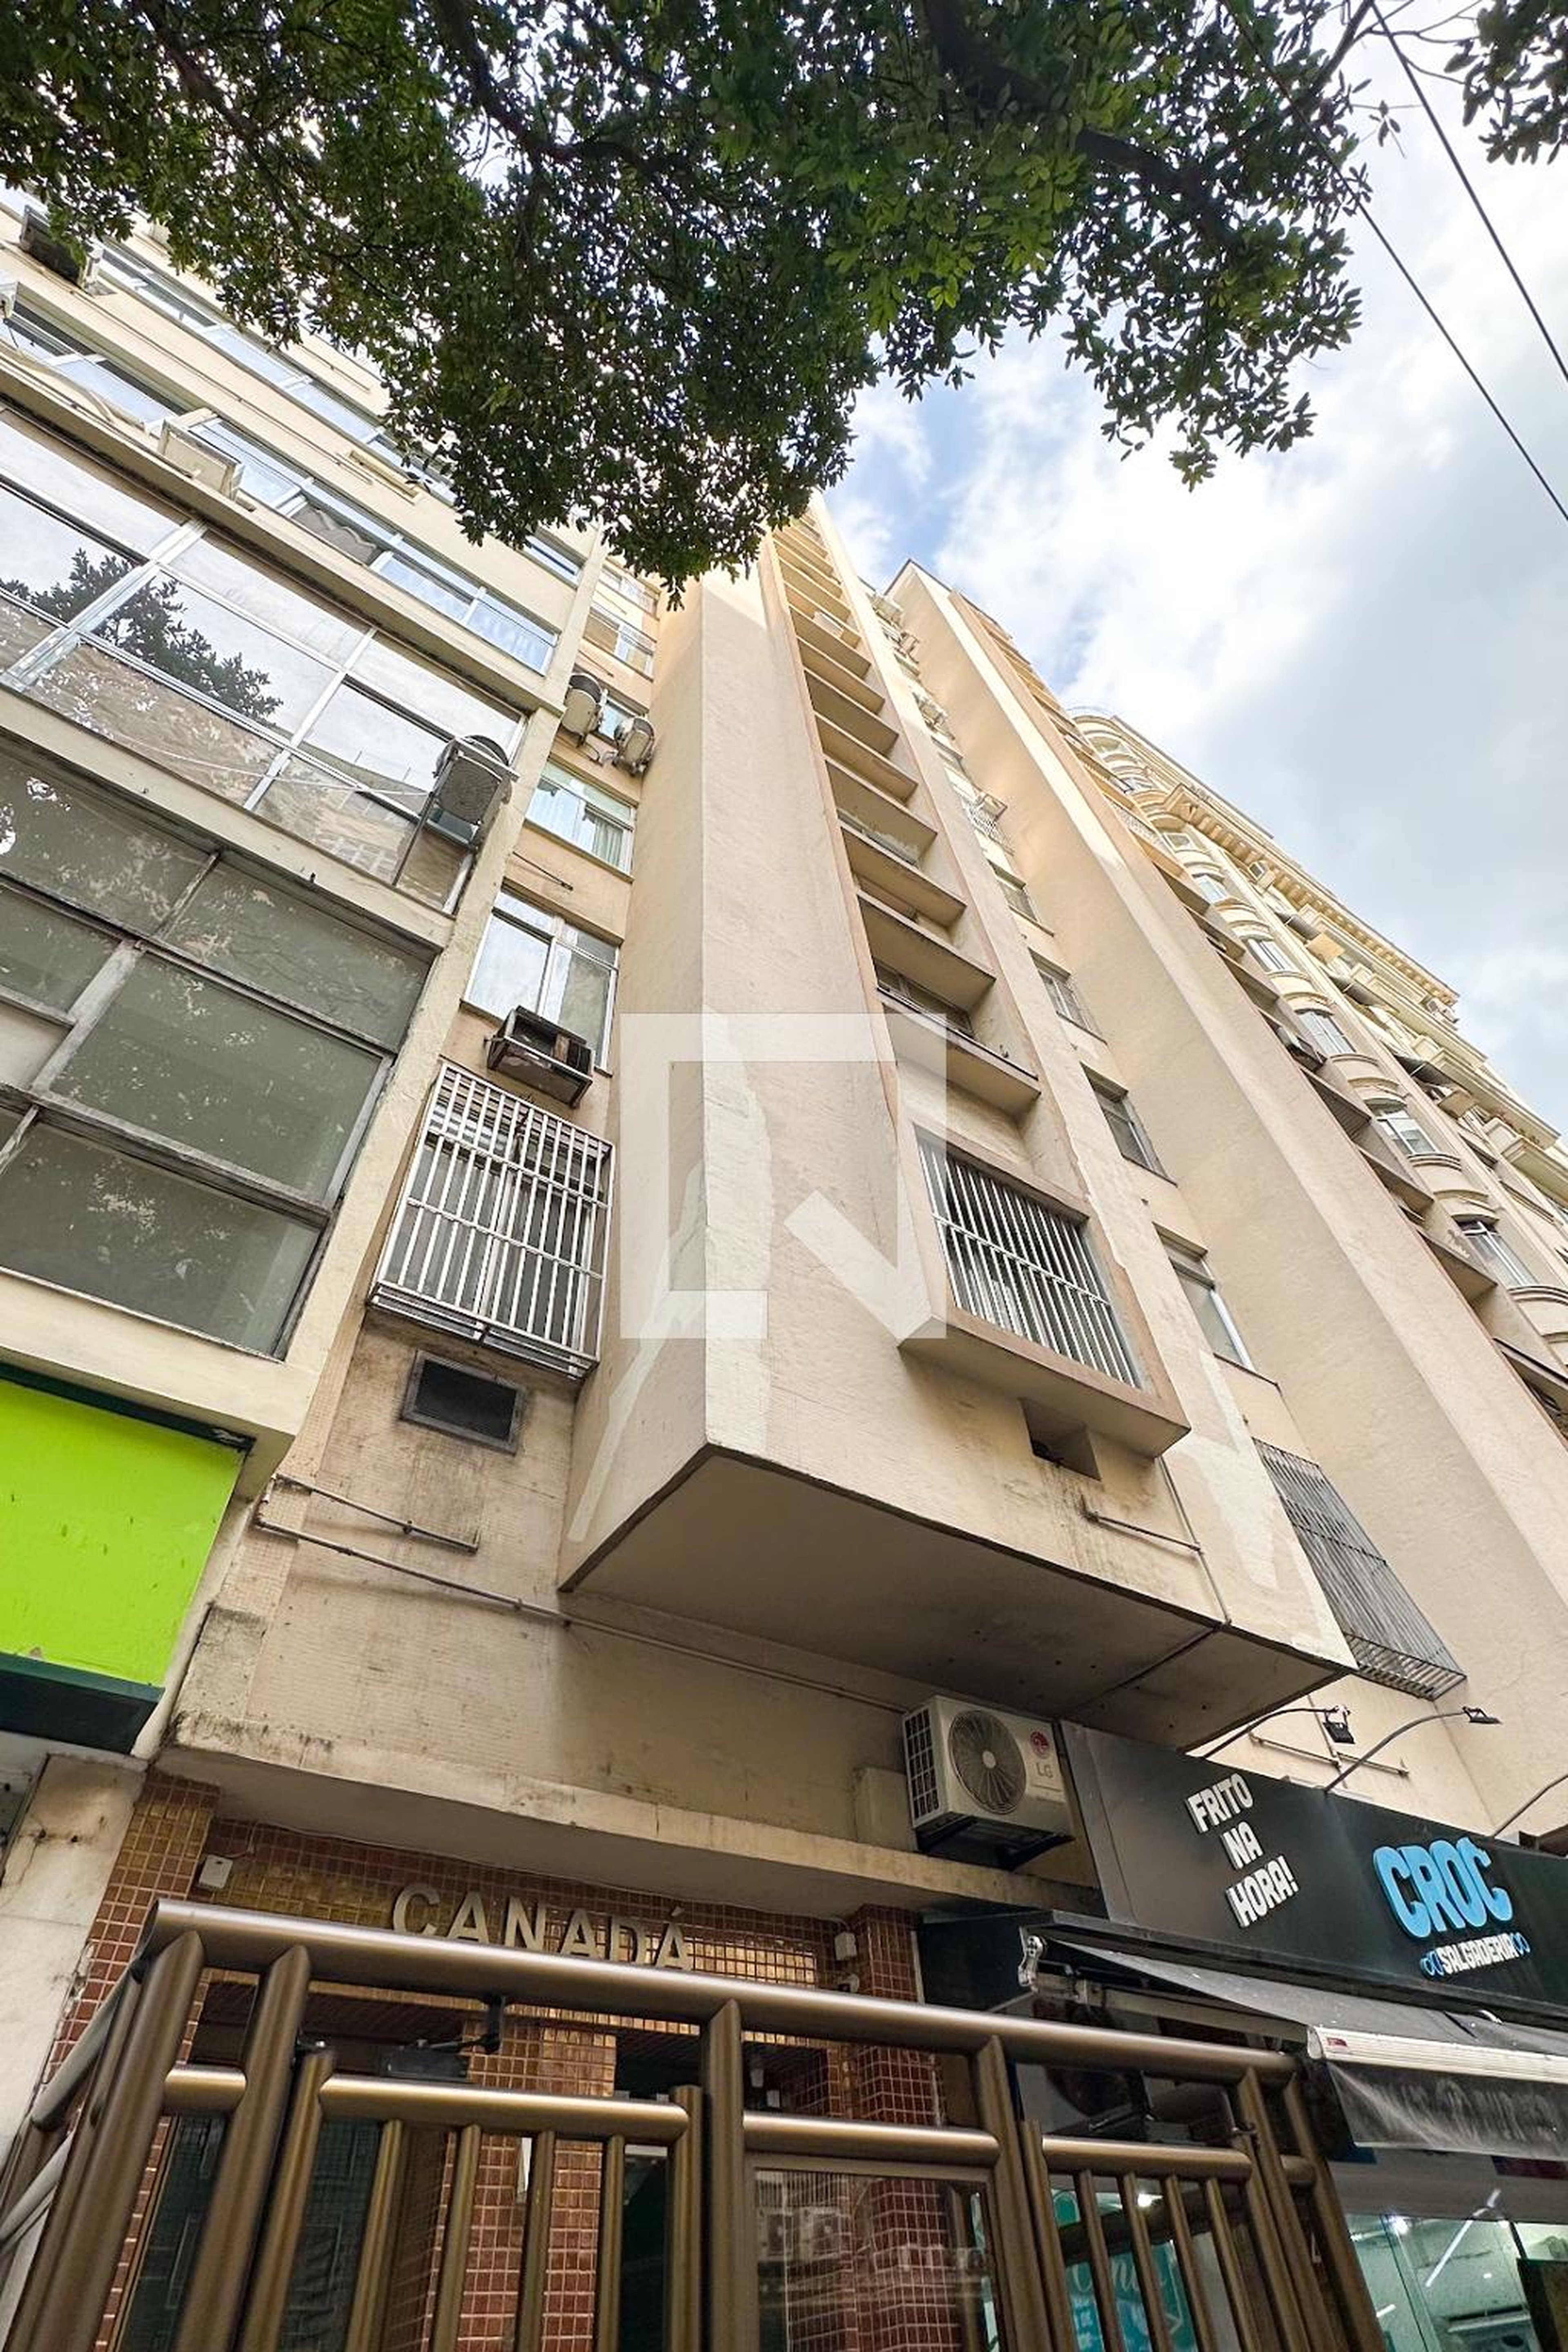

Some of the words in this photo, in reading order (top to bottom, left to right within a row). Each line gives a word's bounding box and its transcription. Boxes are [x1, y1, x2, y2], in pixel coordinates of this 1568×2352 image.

[1036, 1762, 1054, 1778] LG
[1186, 1773, 1254, 1833] FRITO
[1221, 1821, 1264, 1870] NA
[1226, 1855, 1299, 1927] HORA!
[1373, 1837, 1513, 1938] CROC
[392, 1884, 693, 1971] CANADÁ
[1435, 1932, 1521, 1975] SALGADERIA
